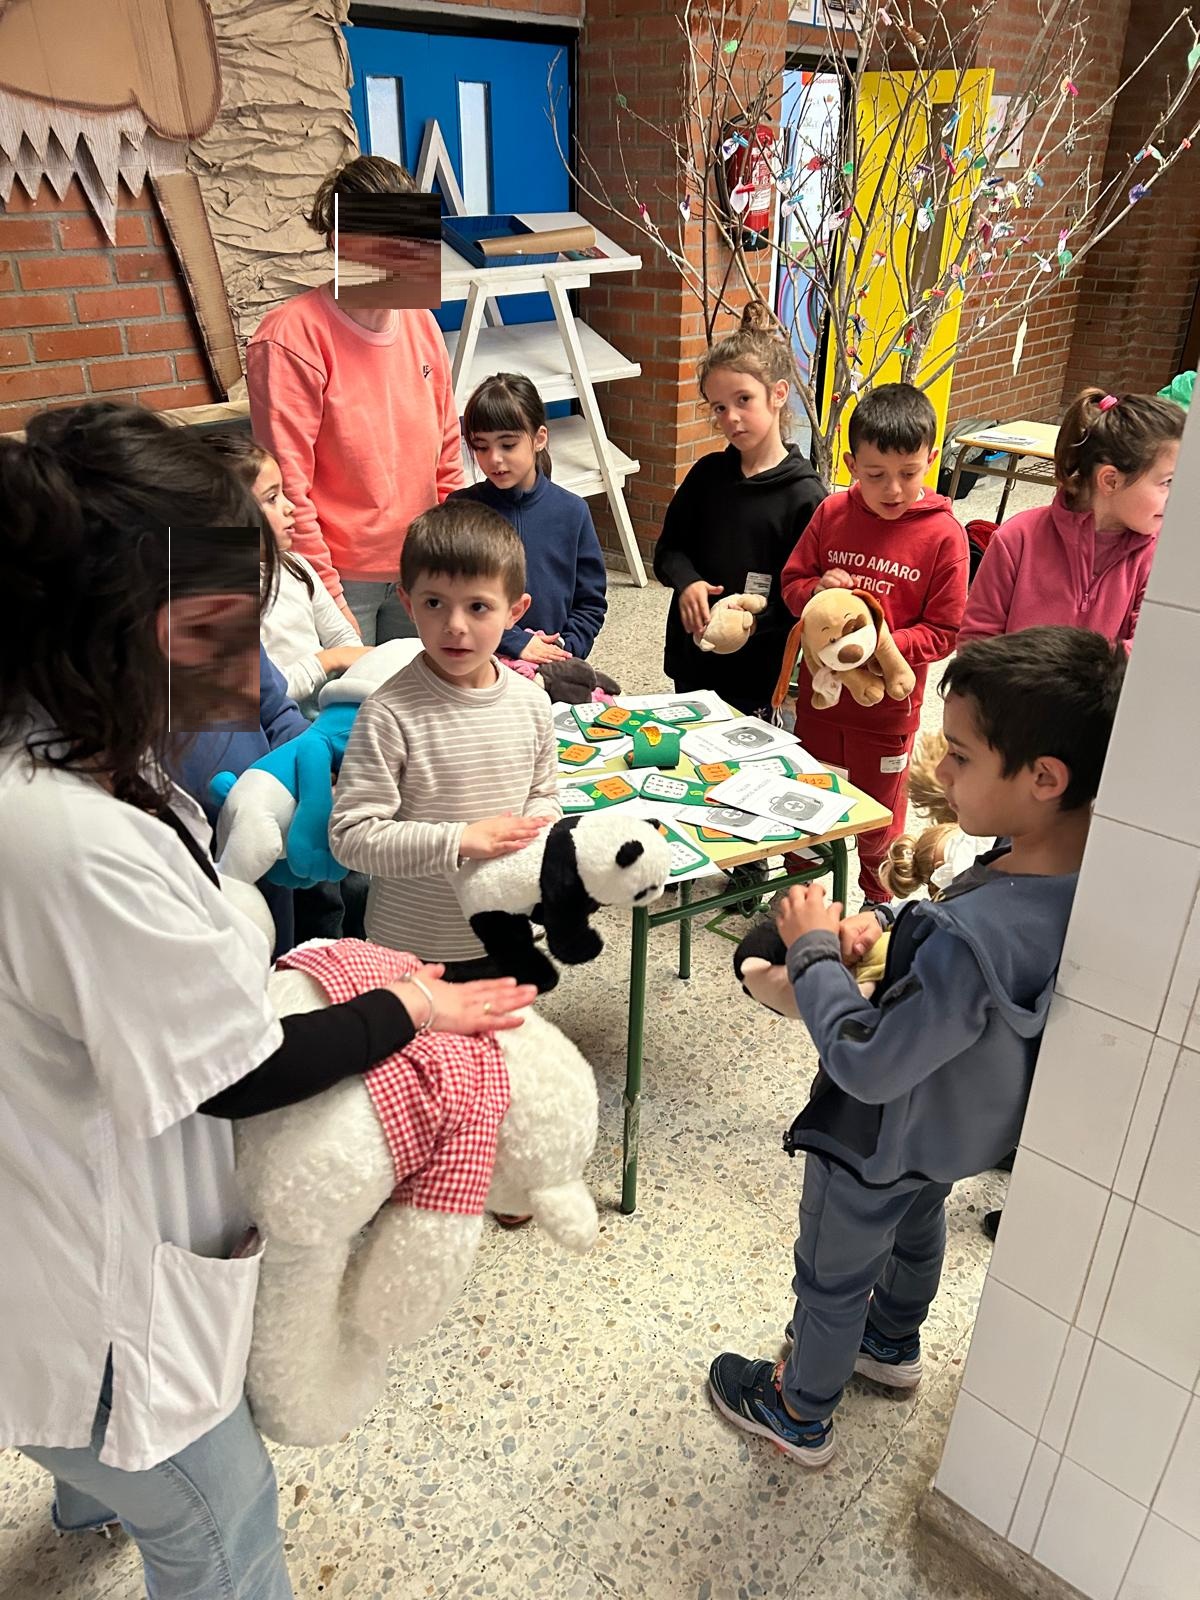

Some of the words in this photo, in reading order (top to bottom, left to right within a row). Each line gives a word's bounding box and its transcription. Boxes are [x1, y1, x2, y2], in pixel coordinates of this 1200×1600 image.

[827, 550, 866, 567] SANTO
[866, 556, 921, 582] AMARO
[851, 573, 895, 595] TRICT
